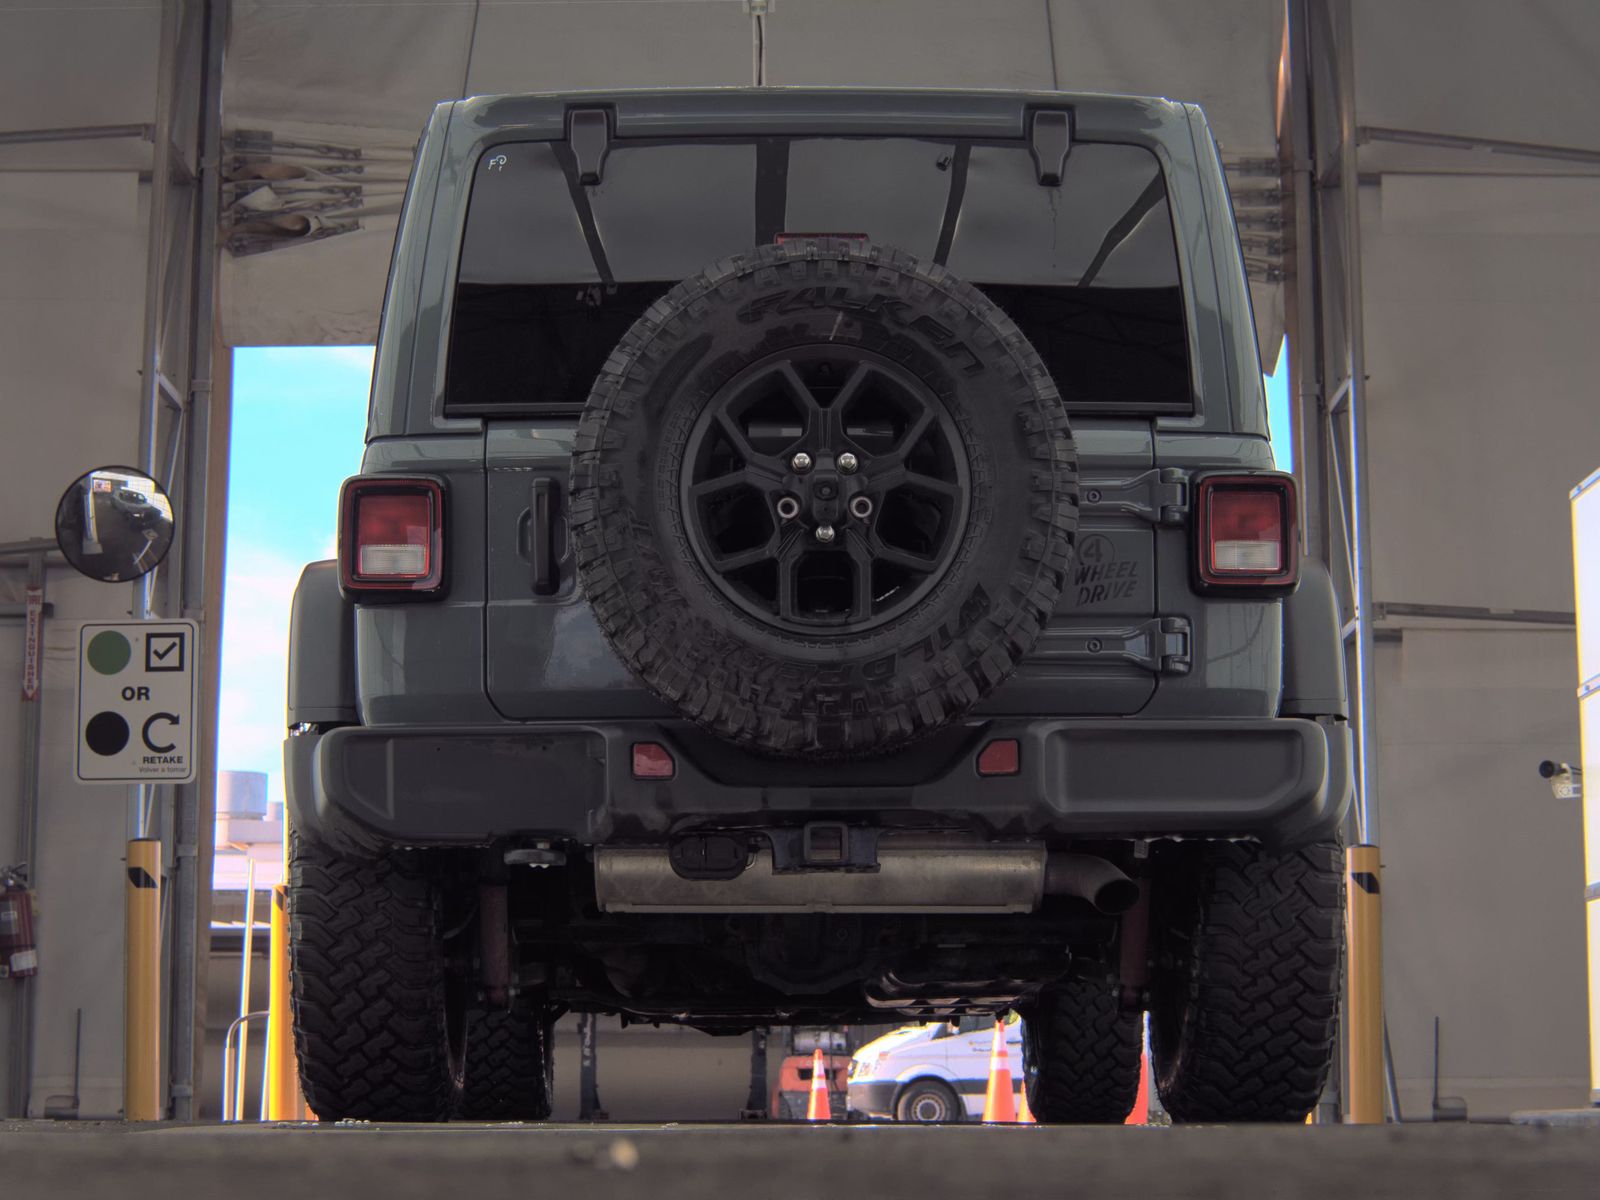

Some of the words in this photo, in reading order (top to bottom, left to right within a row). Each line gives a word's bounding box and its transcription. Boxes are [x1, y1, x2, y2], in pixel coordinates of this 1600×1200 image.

[1074, 561, 1138, 586] WHEEL
[1076, 580, 1138, 606] DRIVE
[122, 686, 150, 701] OR
[142, 756, 183, 764] RETAKE
